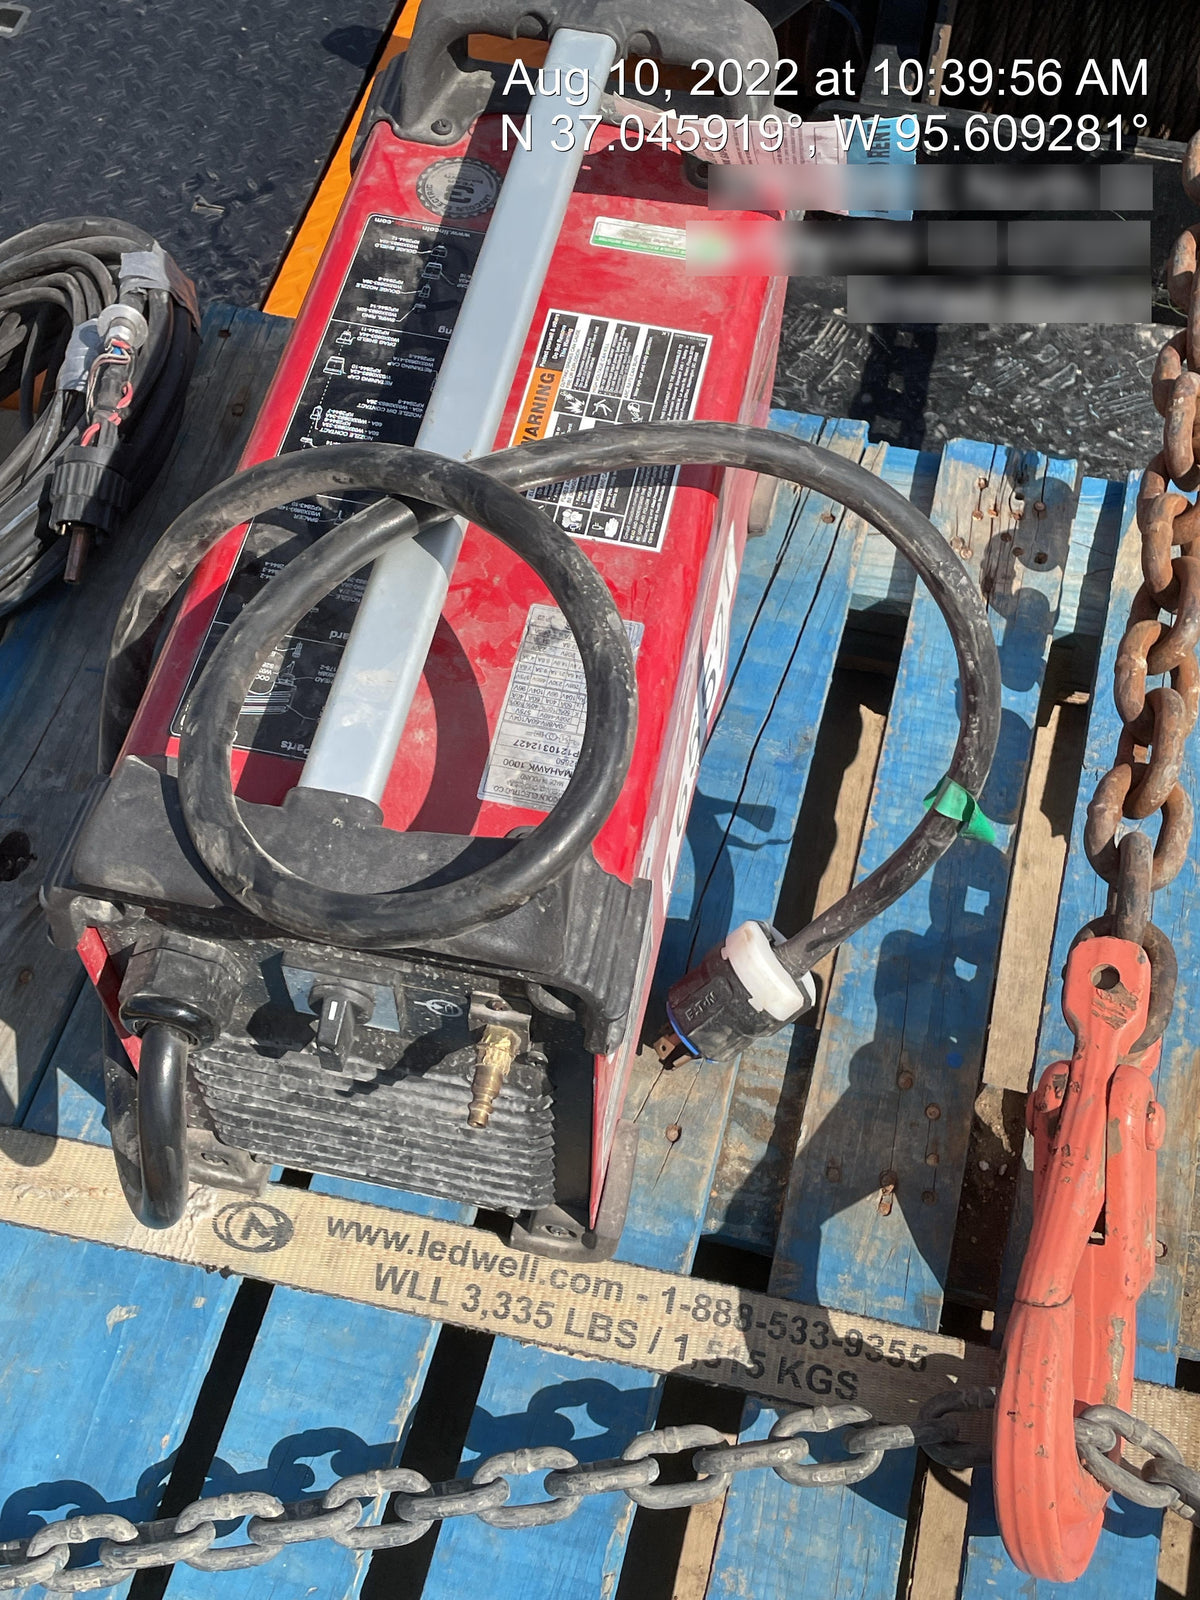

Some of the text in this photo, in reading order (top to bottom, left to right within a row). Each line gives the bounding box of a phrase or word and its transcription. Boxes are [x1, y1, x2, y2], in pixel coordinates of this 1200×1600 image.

[360, 376, 393, 385] RETAINING
[356, 402, 386, 411] CONTACT
[397, 409, 422, 418] NOZZLE
[318, 427, 373, 440] NOZZLE CONTACT
[277, 740, 312, 754] Parts
[501, 758, 573, 777] MAHAWK 1000
[326, 1214, 624, 1304] www.ledwell.com
[661, 1285, 929, 1373] 1-888-533-9355
[374, 1262, 449, 1307] WLL
[460, 1284, 556, 1330] 3,335
[564, 1306, 639, 1350] LBS
[776, 1355, 859, 1401] KGS
